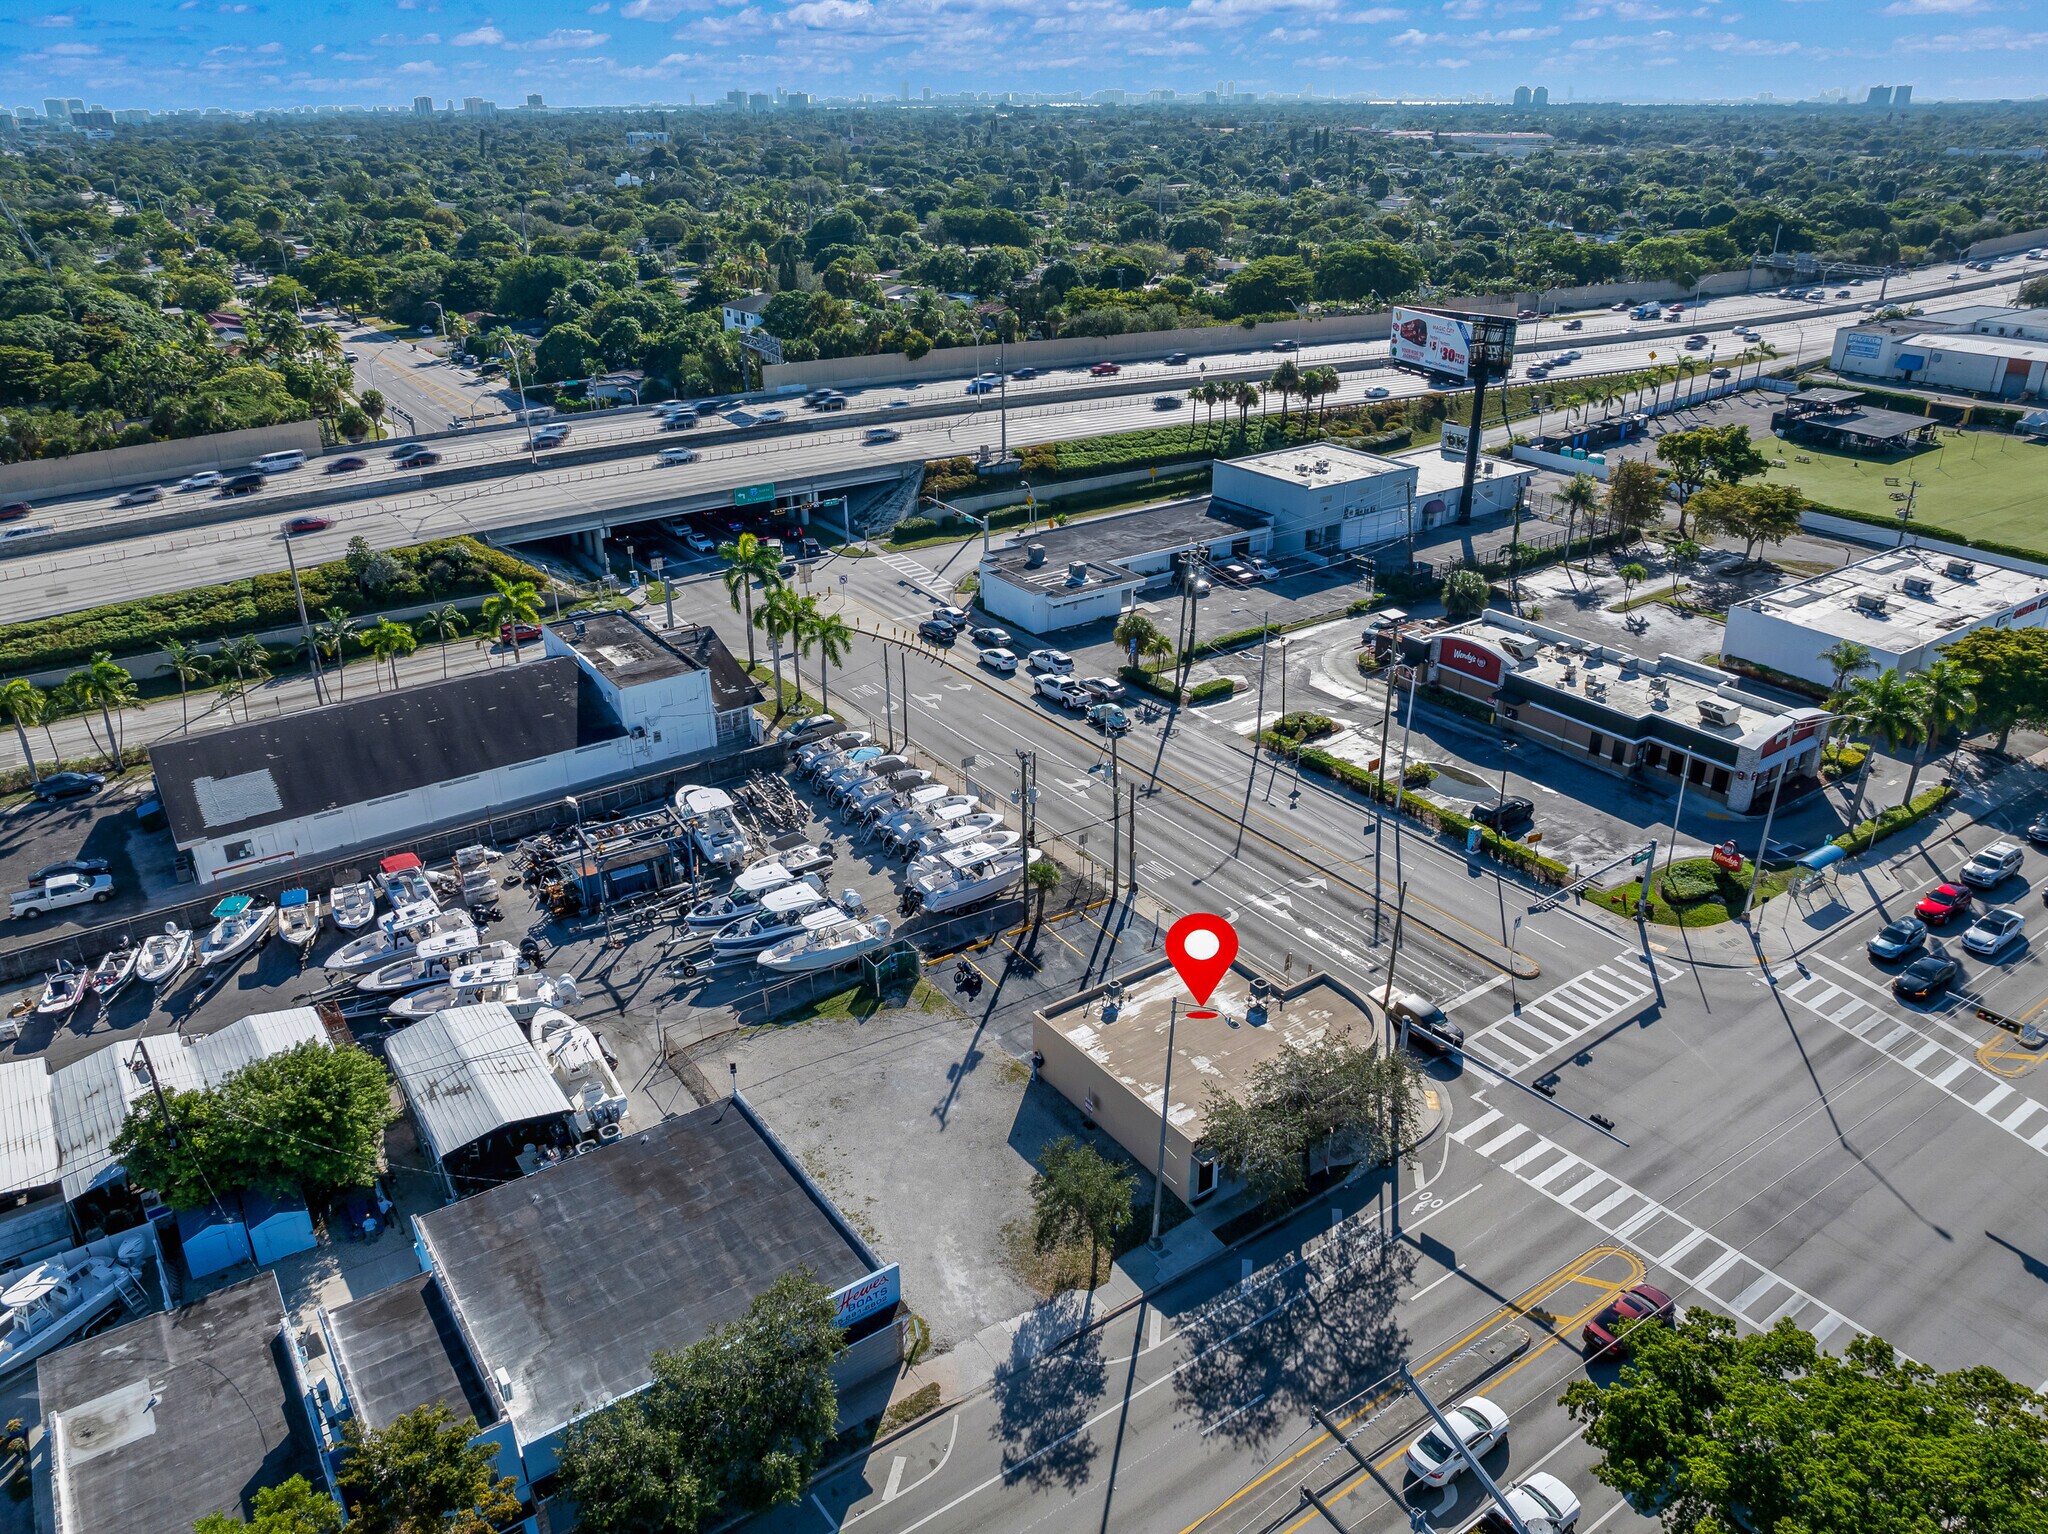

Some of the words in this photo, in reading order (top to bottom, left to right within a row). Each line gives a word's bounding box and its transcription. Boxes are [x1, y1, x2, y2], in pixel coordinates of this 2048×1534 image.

[1453, 649, 1477, 664] Wendy's
[1713, 851, 1739, 867] Wendy's
[1135, 860, 1175, 884] ONLY
[848, 1287, 888, 1312] BOATS
